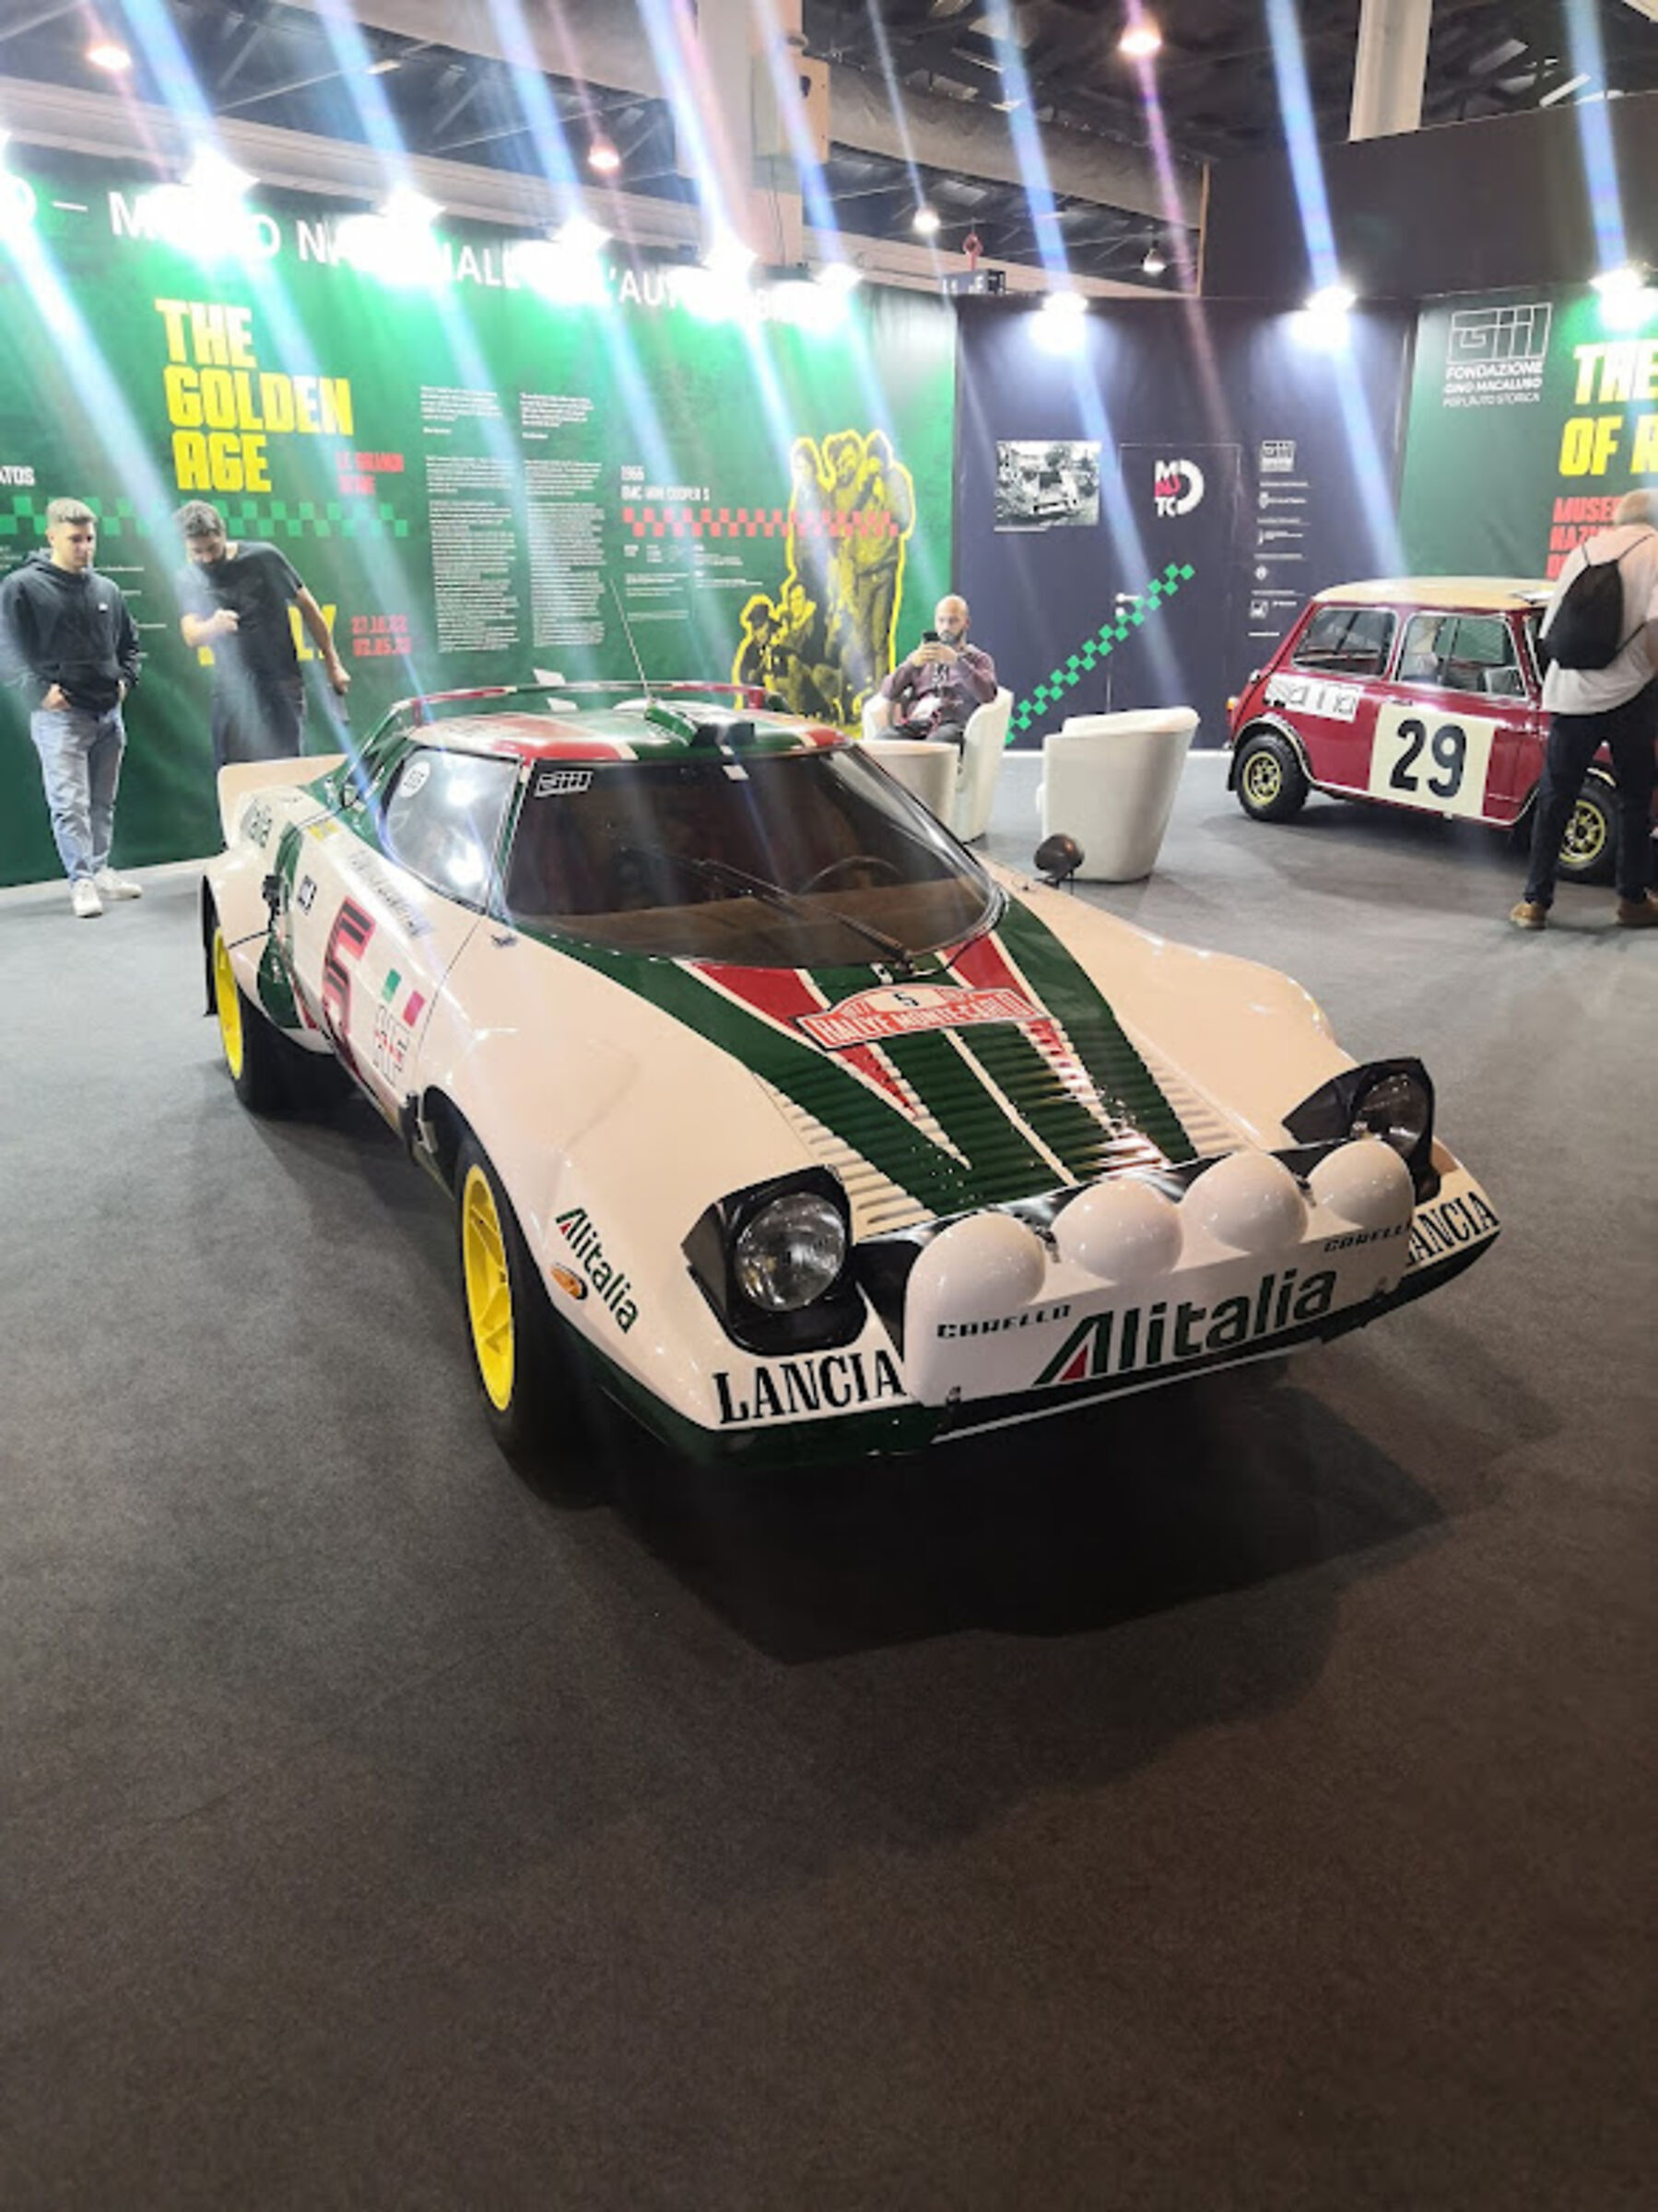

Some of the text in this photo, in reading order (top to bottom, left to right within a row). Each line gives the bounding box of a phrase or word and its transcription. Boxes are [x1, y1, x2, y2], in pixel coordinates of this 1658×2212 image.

[154, 298, 257, 369] THE
[163, 364, 354, 436] GOLDEN
[1445, 360, 1544, 381] FONDAZIONE
[1572, 337, 1658, 405] THE
[171, 429, 273, 493] AGE
[1558, 416, 1624, 477] OF
[1389, 718, 1467, 798] 29
[807, 1011, 903, 1042] RALLYE
[893, 991, 920, 1006] 5
[1409, 1191, 1500, 1267] ANCIA
[555, 1206, 639, 1335] Alitalia
[936, 1304, 1072, 1338] CARELLO
[1029, 1267, 1338, 1387] Alitalia
[711, 1348, 908, 1425] LANCIA
